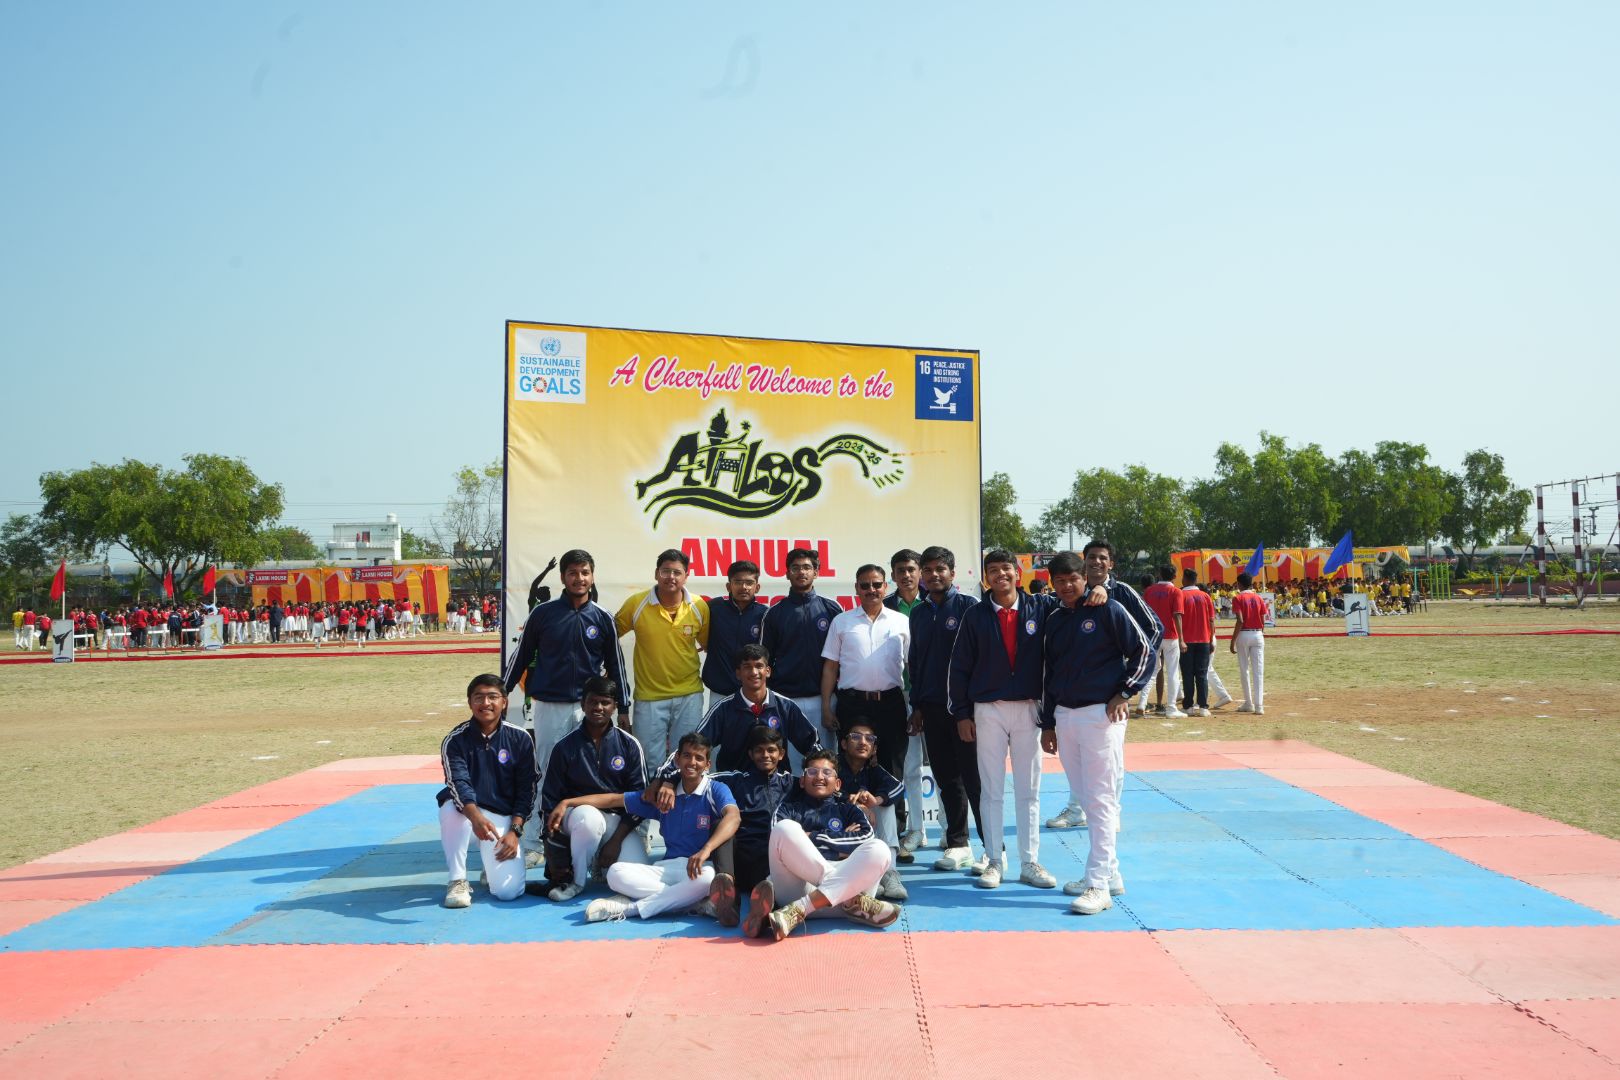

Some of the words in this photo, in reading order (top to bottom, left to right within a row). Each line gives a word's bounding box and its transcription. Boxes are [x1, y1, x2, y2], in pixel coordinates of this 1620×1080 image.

[519, 356, 581, 368] SUSTAINABLE
[919, 360, 931, 375] 16
[519, 366, 581, 377] DEVELOPMENT
[610, 355, 639, 385] A
[643, 356, 743, 399] Cheerfull
[746, 364, 833, 396] Welcome
[838, 374, 858, 397] to
[864, 369, 894, 399] the
[943, 369, 959, 377] STRONG
[519, 375, 581, 396] GOALS
[680, 537, 836, 578] ANNUL
